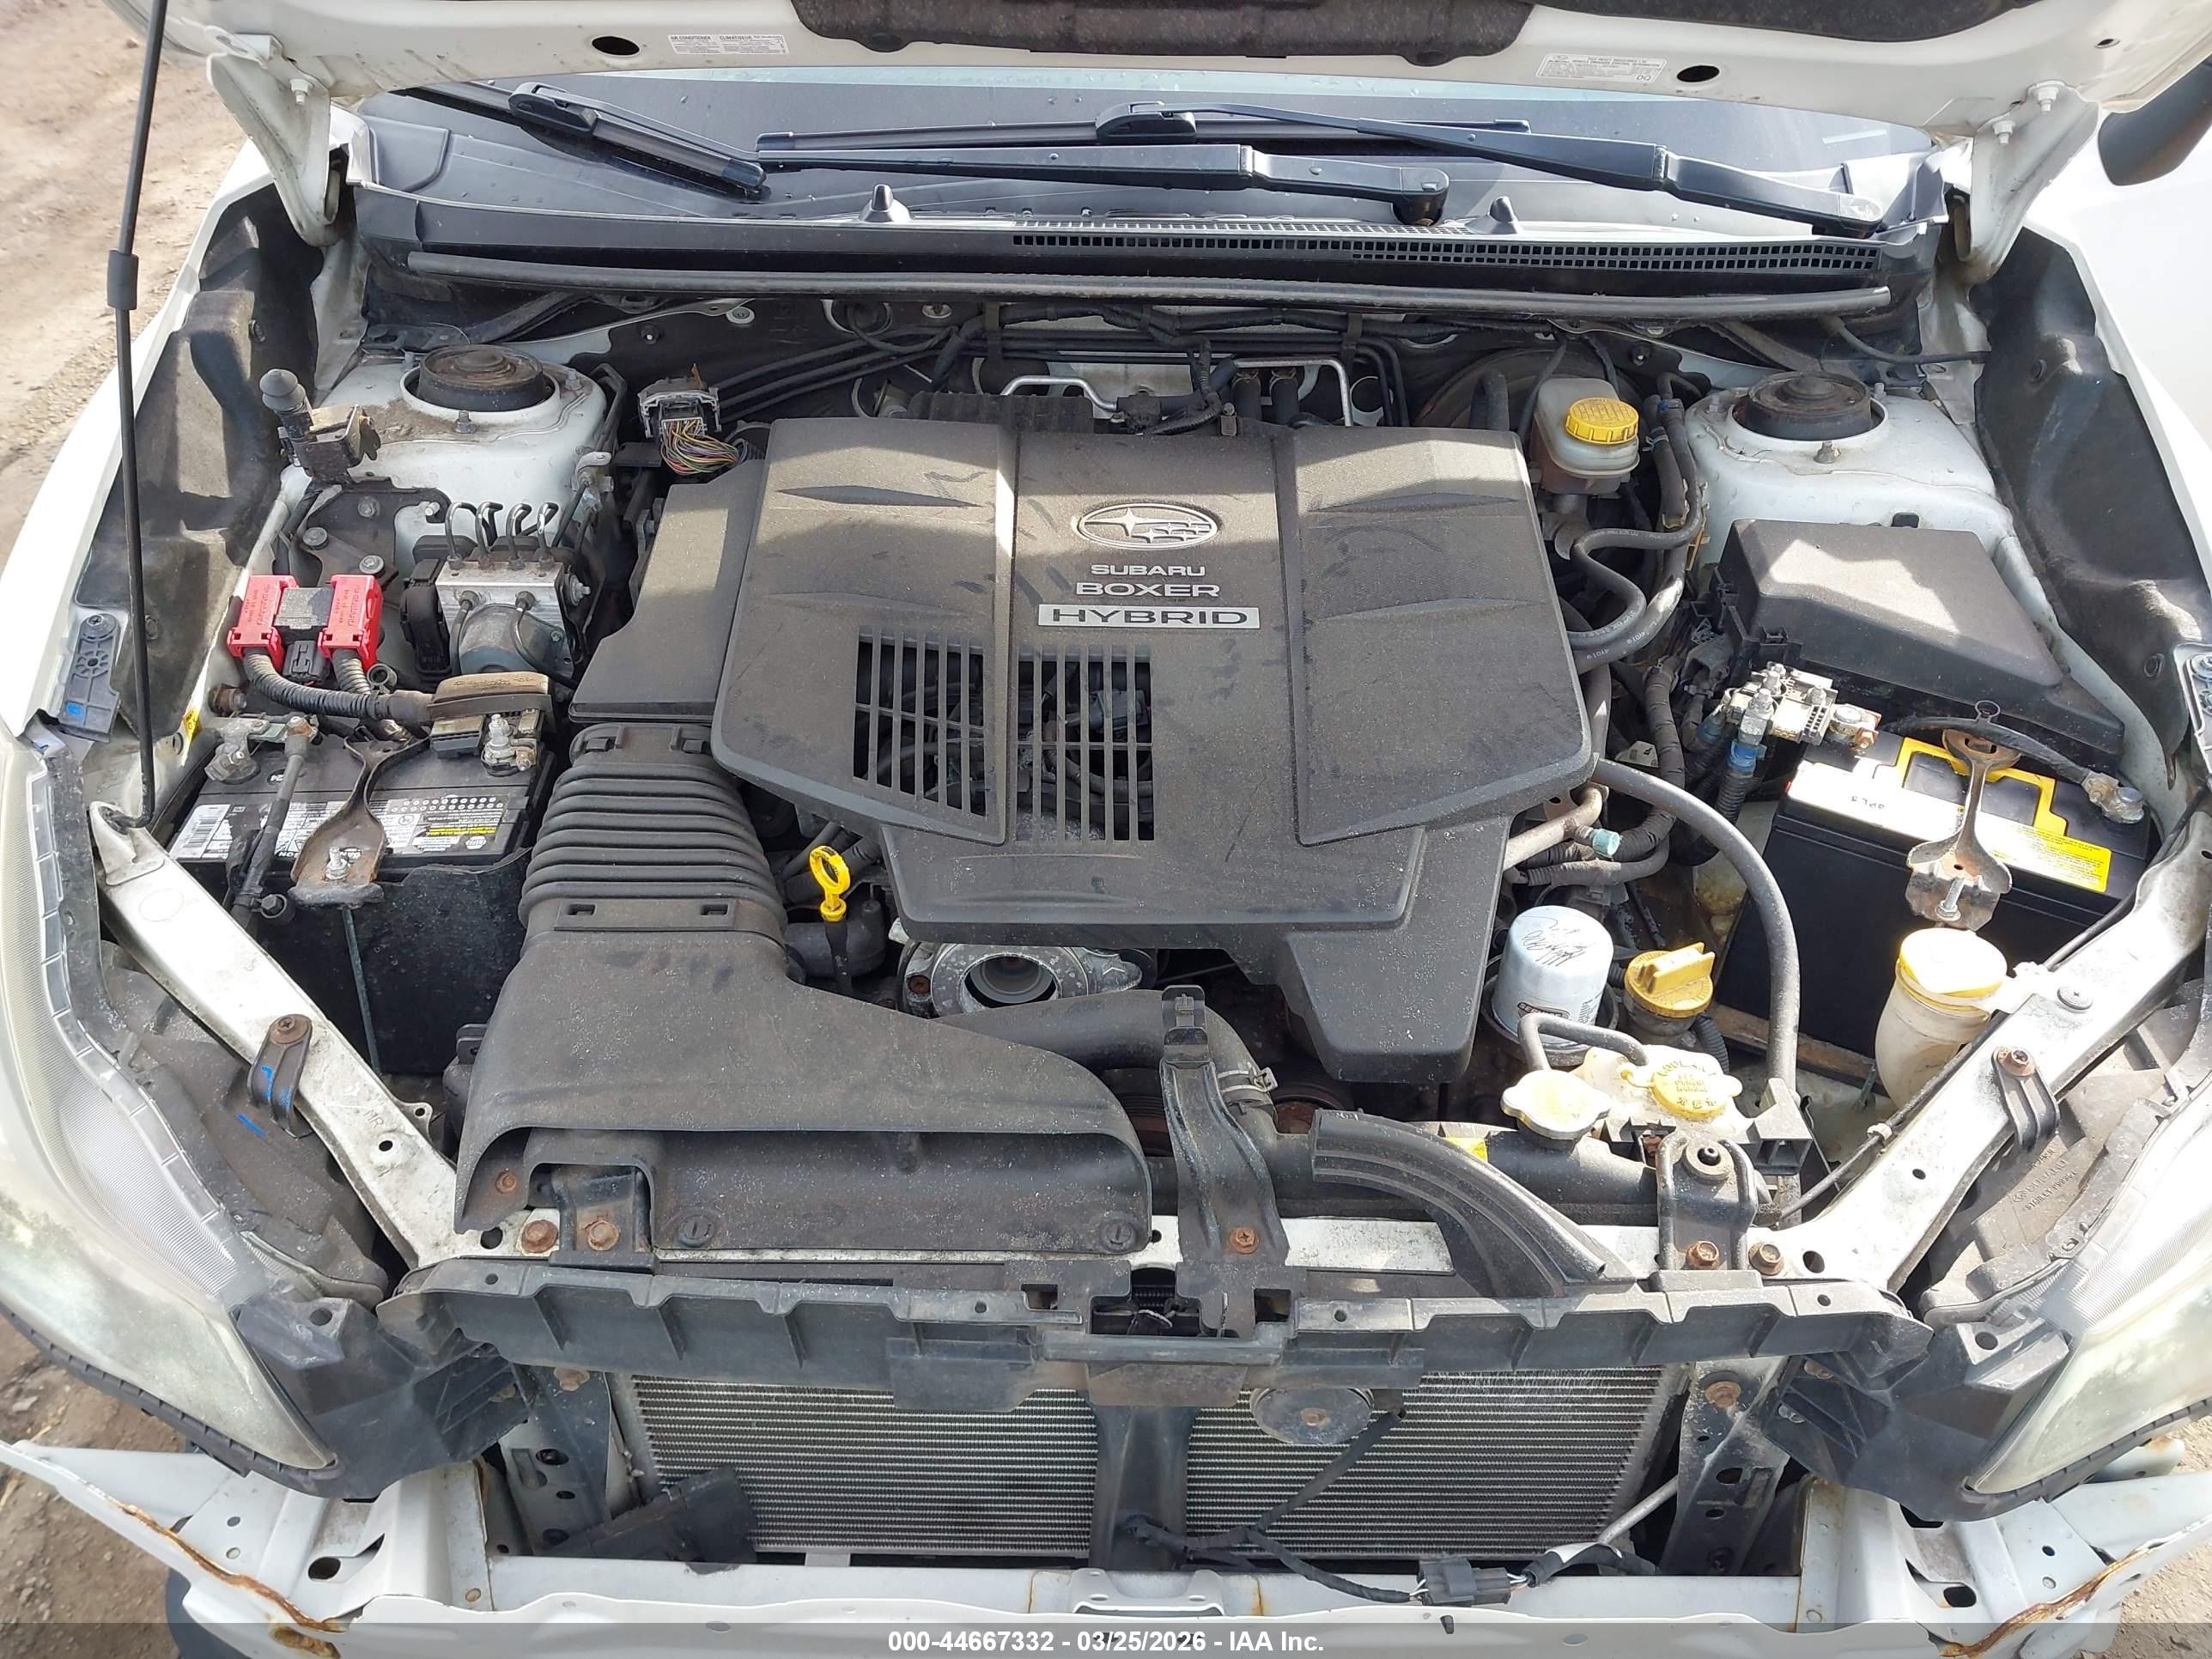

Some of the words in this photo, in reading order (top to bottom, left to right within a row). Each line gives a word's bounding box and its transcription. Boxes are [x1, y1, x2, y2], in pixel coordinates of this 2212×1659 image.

[1091, 564, 1206, 577] SUBARU
[1076, 582, 1220, 598] BOXER
[1053, 608, 1248, 625] HYBRID
